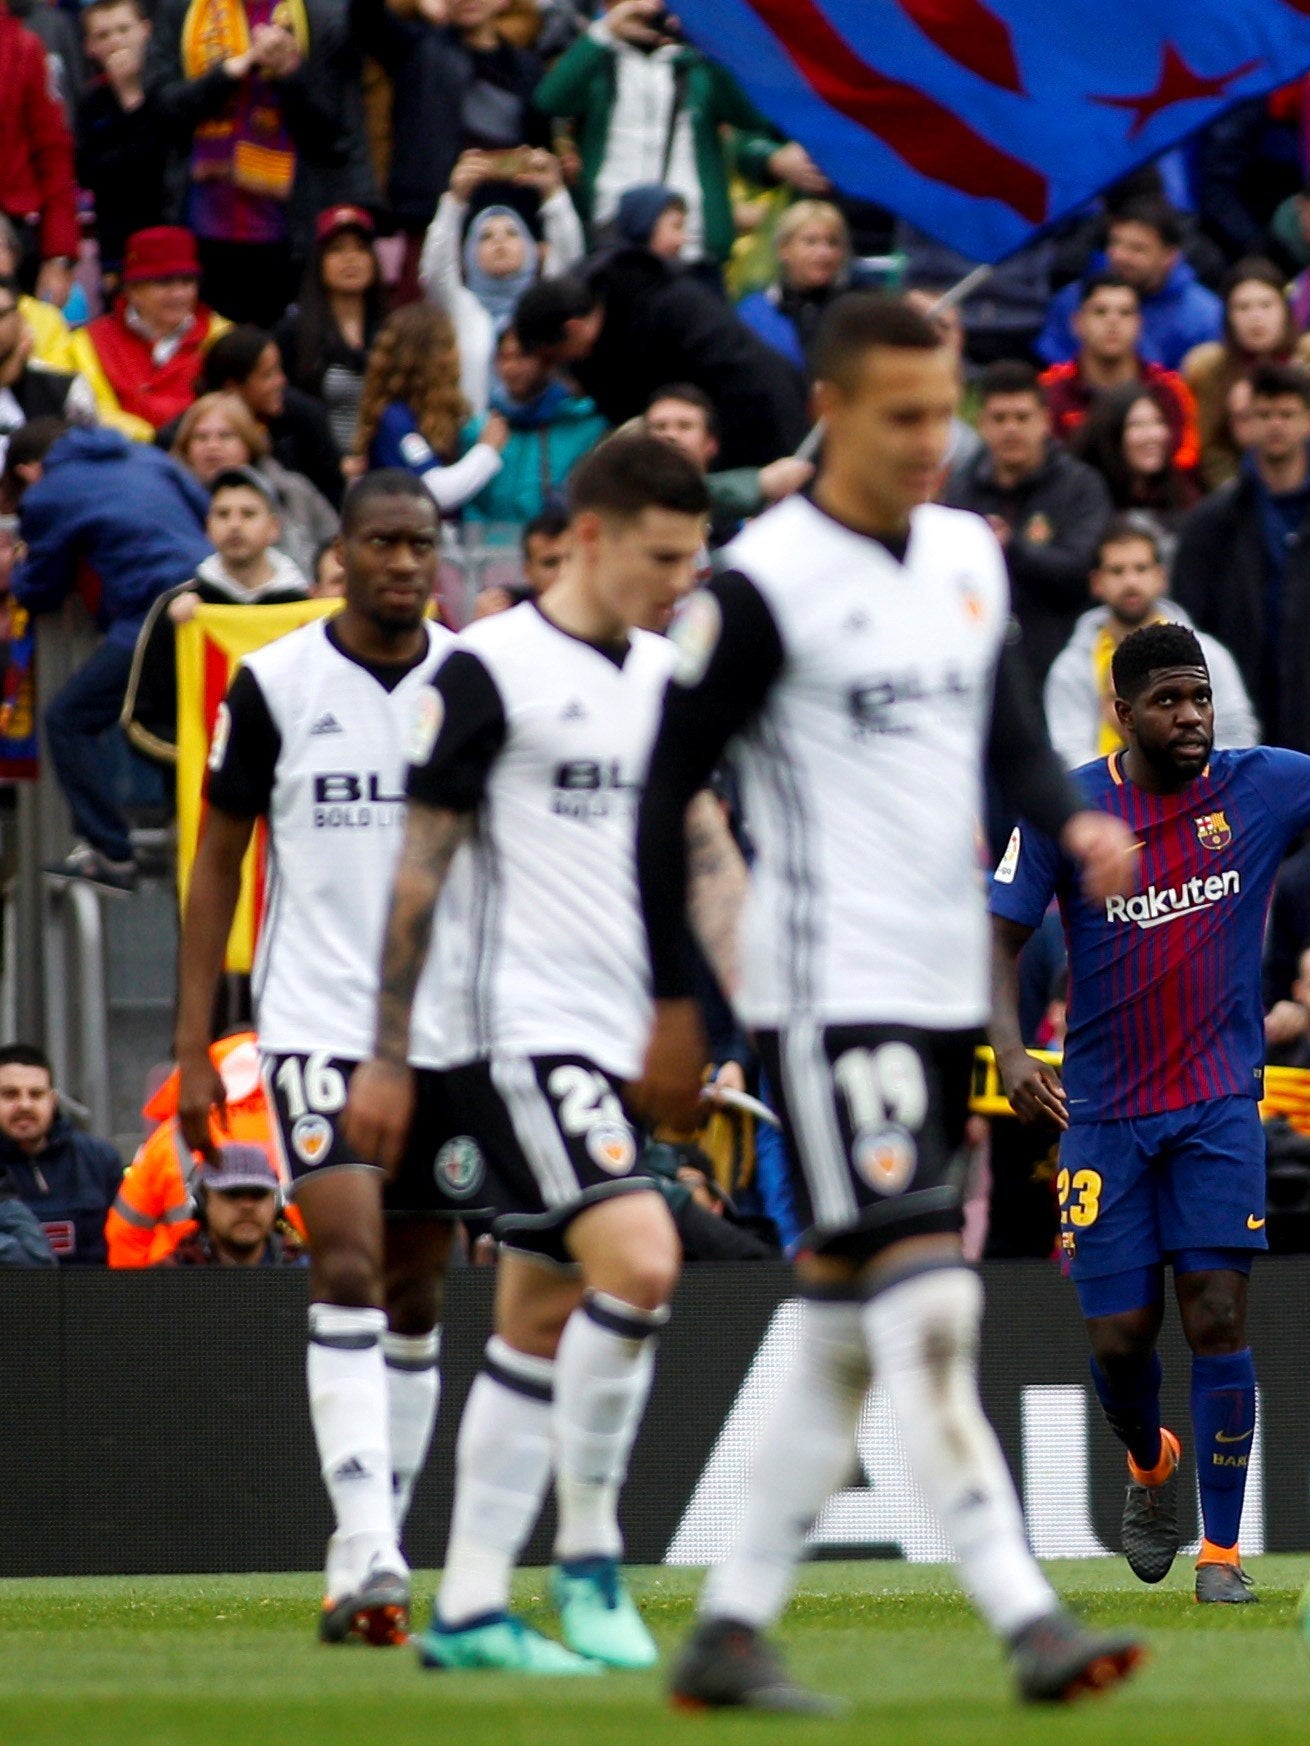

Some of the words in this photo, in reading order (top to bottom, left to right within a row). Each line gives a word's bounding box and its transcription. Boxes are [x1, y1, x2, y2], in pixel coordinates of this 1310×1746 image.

[1105, 870, 1240, 923] Rakuten
[276, 1050, 347, 1118] 16
[833, 1040, 928, 1133] 19
[1057, 1168, 1102, 1227] 23
